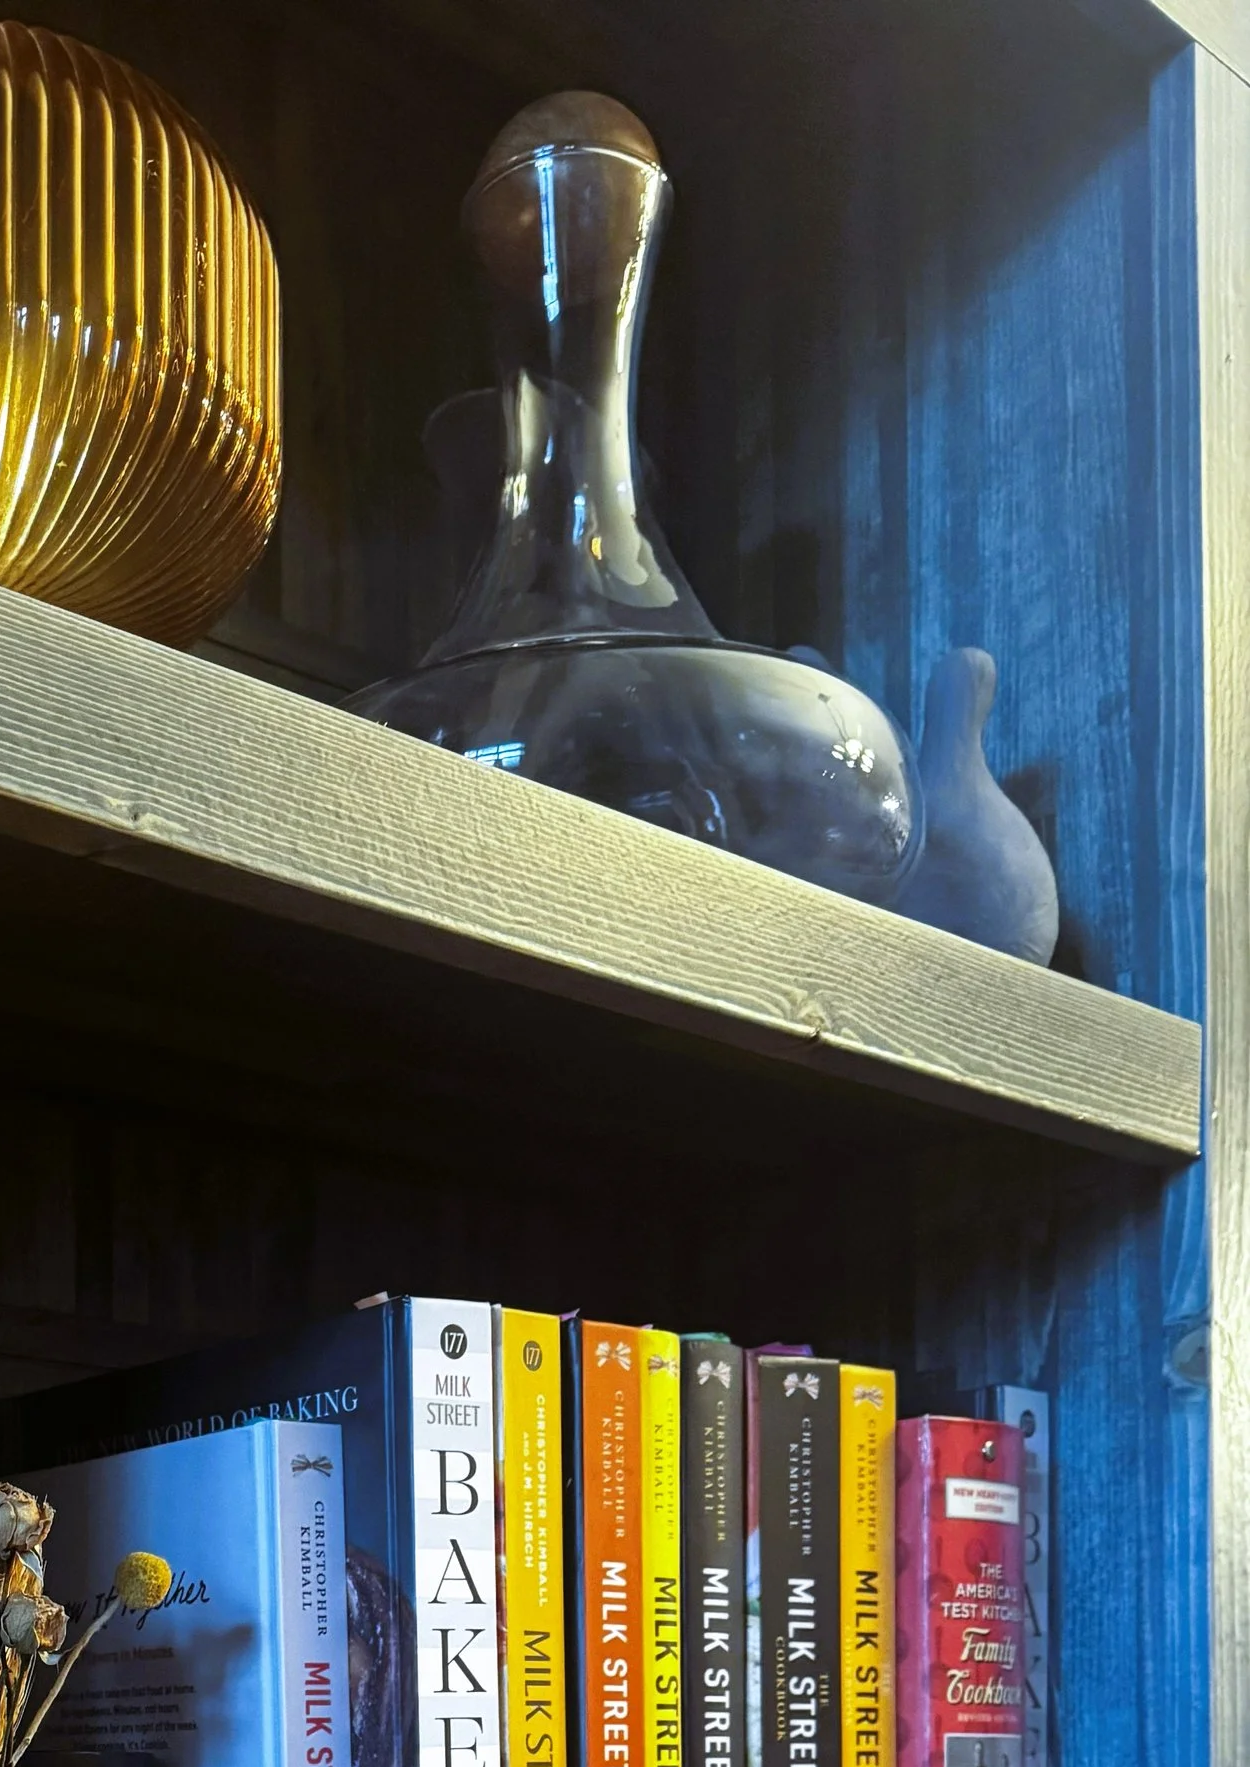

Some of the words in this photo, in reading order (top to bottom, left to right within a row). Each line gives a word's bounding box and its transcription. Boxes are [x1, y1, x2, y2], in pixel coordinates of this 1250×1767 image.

[443, 1331, 465, 1354] 177
[523, 1345, 541, 1367] 177
[269, 1386, 358, 1421] BAKING
[426, 1402, 481, 1428] STREET
[435, 1373, 471, 1398] MILK
[535, 1393, 548, 1519] CHRISTOPHER
[602, 1417, 612, 1509] KIMBALL
[615, 1390, 625, 1538] CHRISTOPHER
[654, 1424, 663, 1514] KIMBALL
[704, 1427, 714, 1513] KIMBALL
[717, 1401, 727, 1541] CHRISTOPHER
[789, 1443, 799, 1528] KIMBALL
[801, 1417, 812, 1556] CHRISTOPHER
[857, 1443, 865, 1524] KIMBALL
[867, 1419, 877, 1553] CHRISTOPHER
[300, 1526, 313, 1612] KIMBALL
[313, 1500, 328, 1637] CHRISTOPHER
[524, 1501, 534, 1568] HIRSCH
[538, 1527, 549, 1607] KIMBALL
[980, 1563, 1003, 1579] THE
[602, 1561, 627, 1644] MILK
[654, 1577, 678, 1662] MILK
[702, 1568, 730, 1654] MILK
[787, 1578, 815, 1661] MILK
[855, 1571, 879, 1649] MILK
[941, 1602, 978, 1619] TEST
[523, 1630, 552, 1721] MILK
[775, 1636, 787, 1742] COOKBOOK
[960, 1627, 1017, 1670] Family
[304, 1661, 332, 1737] MILK
